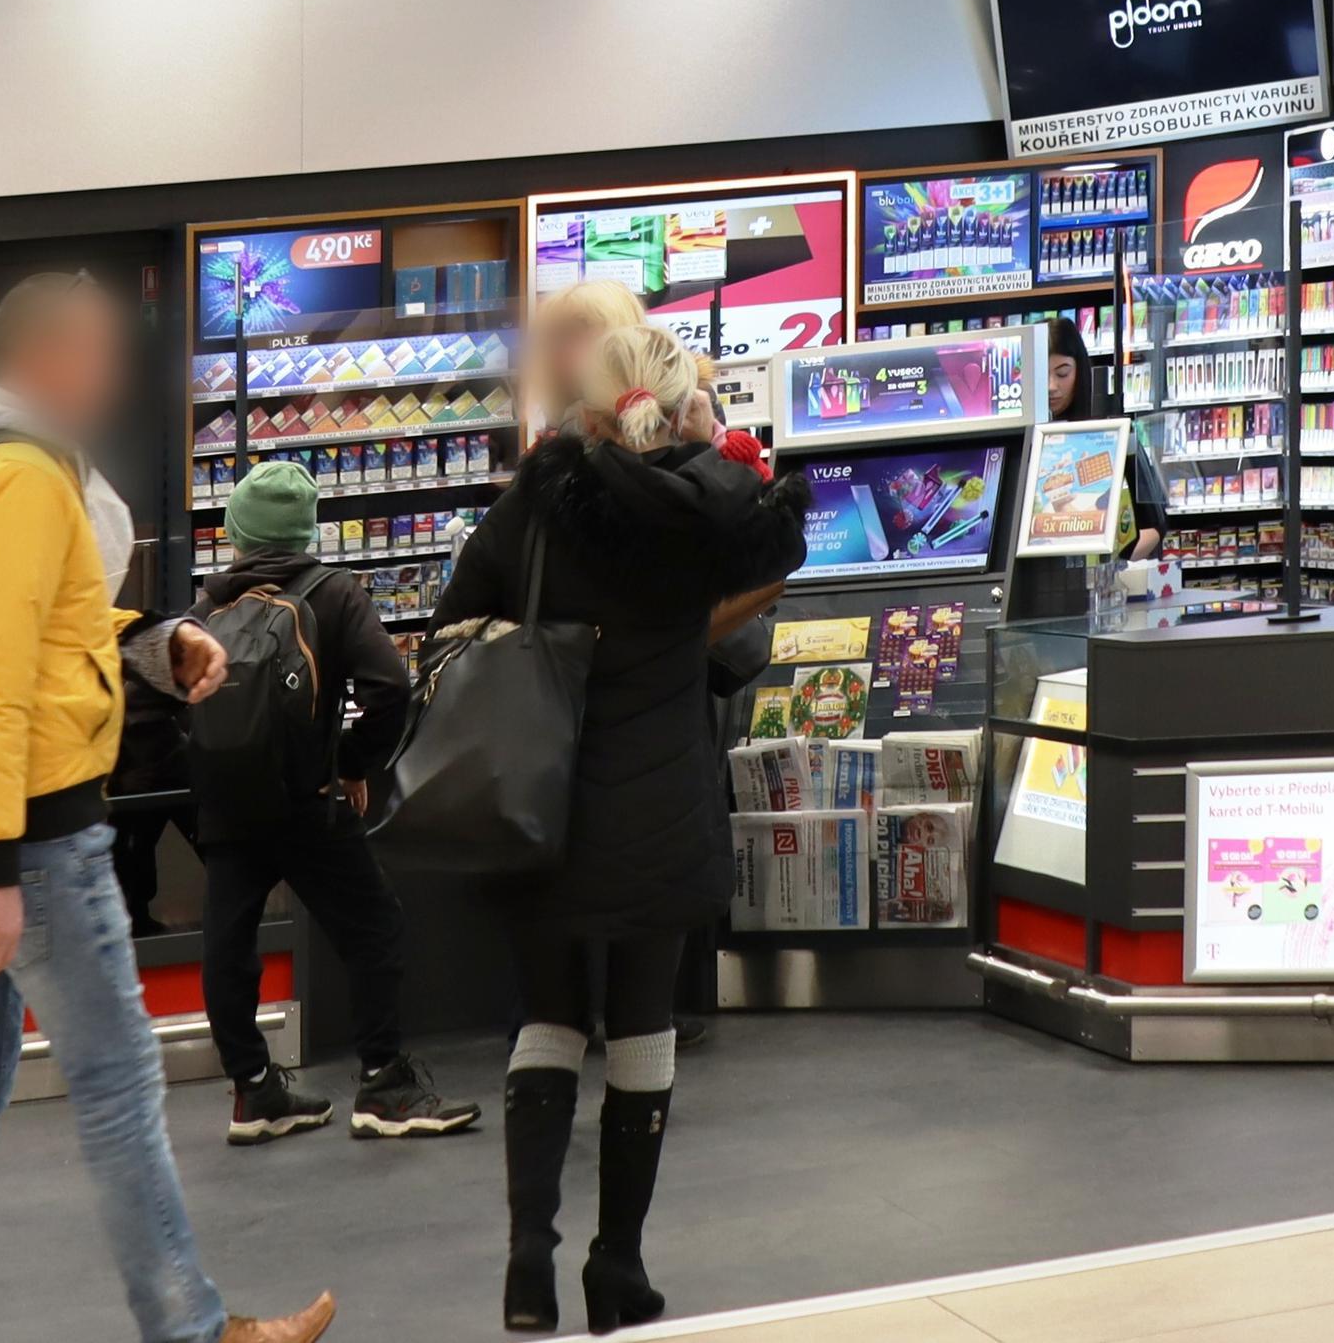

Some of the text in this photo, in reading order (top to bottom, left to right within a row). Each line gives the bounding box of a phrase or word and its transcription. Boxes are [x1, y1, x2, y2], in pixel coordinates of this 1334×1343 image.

[1148, 19, 1203, 34] TRULY UNIQUE
[1019, 83, 1314, 136] MINISTERSTVO ZDRAVOTNICTVÍ VARUJE:
[1020, 130, 1100, 153] KOUŘENÍ
[1220, 98, 1315, 123] RAKOVINU
[879, 194, 895, 206] blu
[979, 182, 1013, 202] 3+1
[306, 234, 373, 262] 490 Kč
[1183, 239, 1263, 268] GECO
[867, 282, 927, 294] MINISTERSTVO
[272, 335, 309, 348] PULZE
[917, 381, 928, 394] 3
[806, 521, 828, 531] VĚT
[1043, 516, 1093, 532] 5x milion
[827, 542, 842, 550] GO
[838, 751, 853, 799] deník
[925, 749, 947, 791] DNES
[1209, 784, 1260, 800] Vyberte
[1265, 785, 1275, 796] si
[1278, 787, 1284, 795] z
[1209, 803, 1324, 817] karet od T-Mobilu
[902, 846, 924, 897] Aha!
